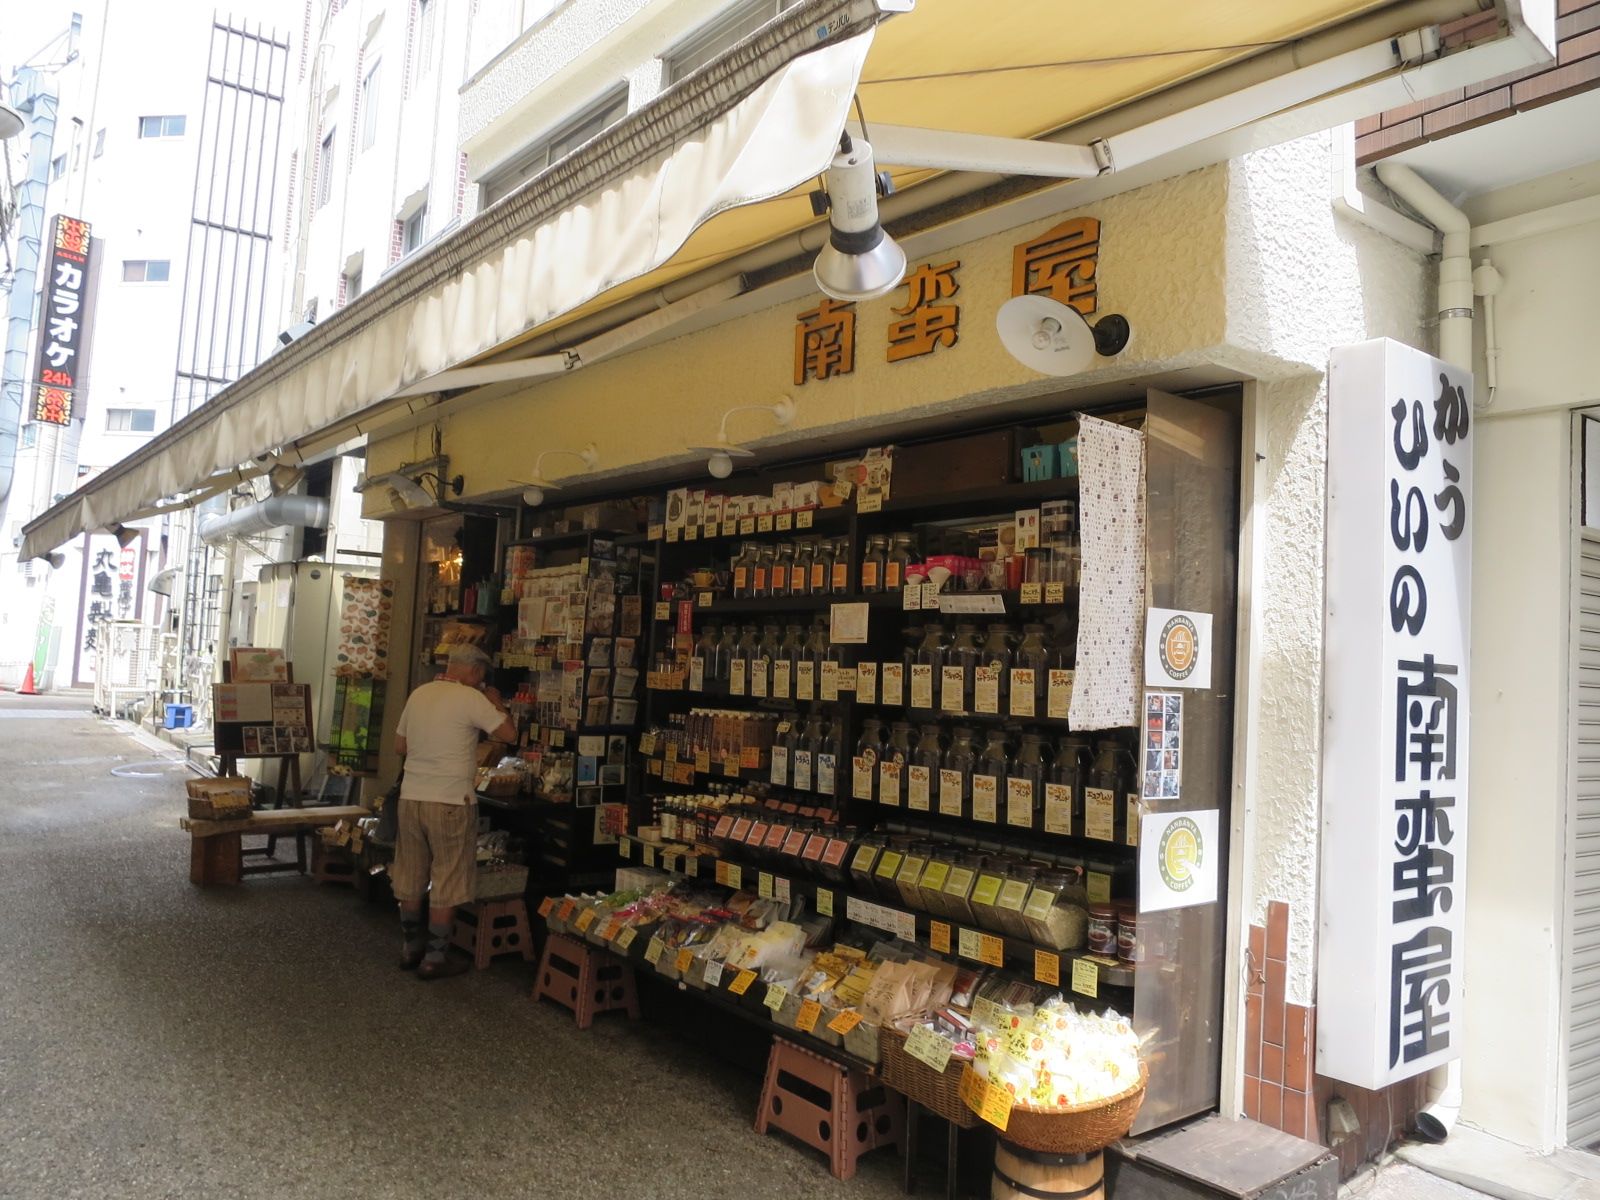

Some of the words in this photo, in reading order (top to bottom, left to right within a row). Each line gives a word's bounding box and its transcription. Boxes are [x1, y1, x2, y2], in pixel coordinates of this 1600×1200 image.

[46, 262, 83, 368] カラオケ
[42, 368, 73, 387] 24h
[1168, 669, 1189, 679] COFFEE
[1389, 653, 1459, 1071] 南蛮屋
